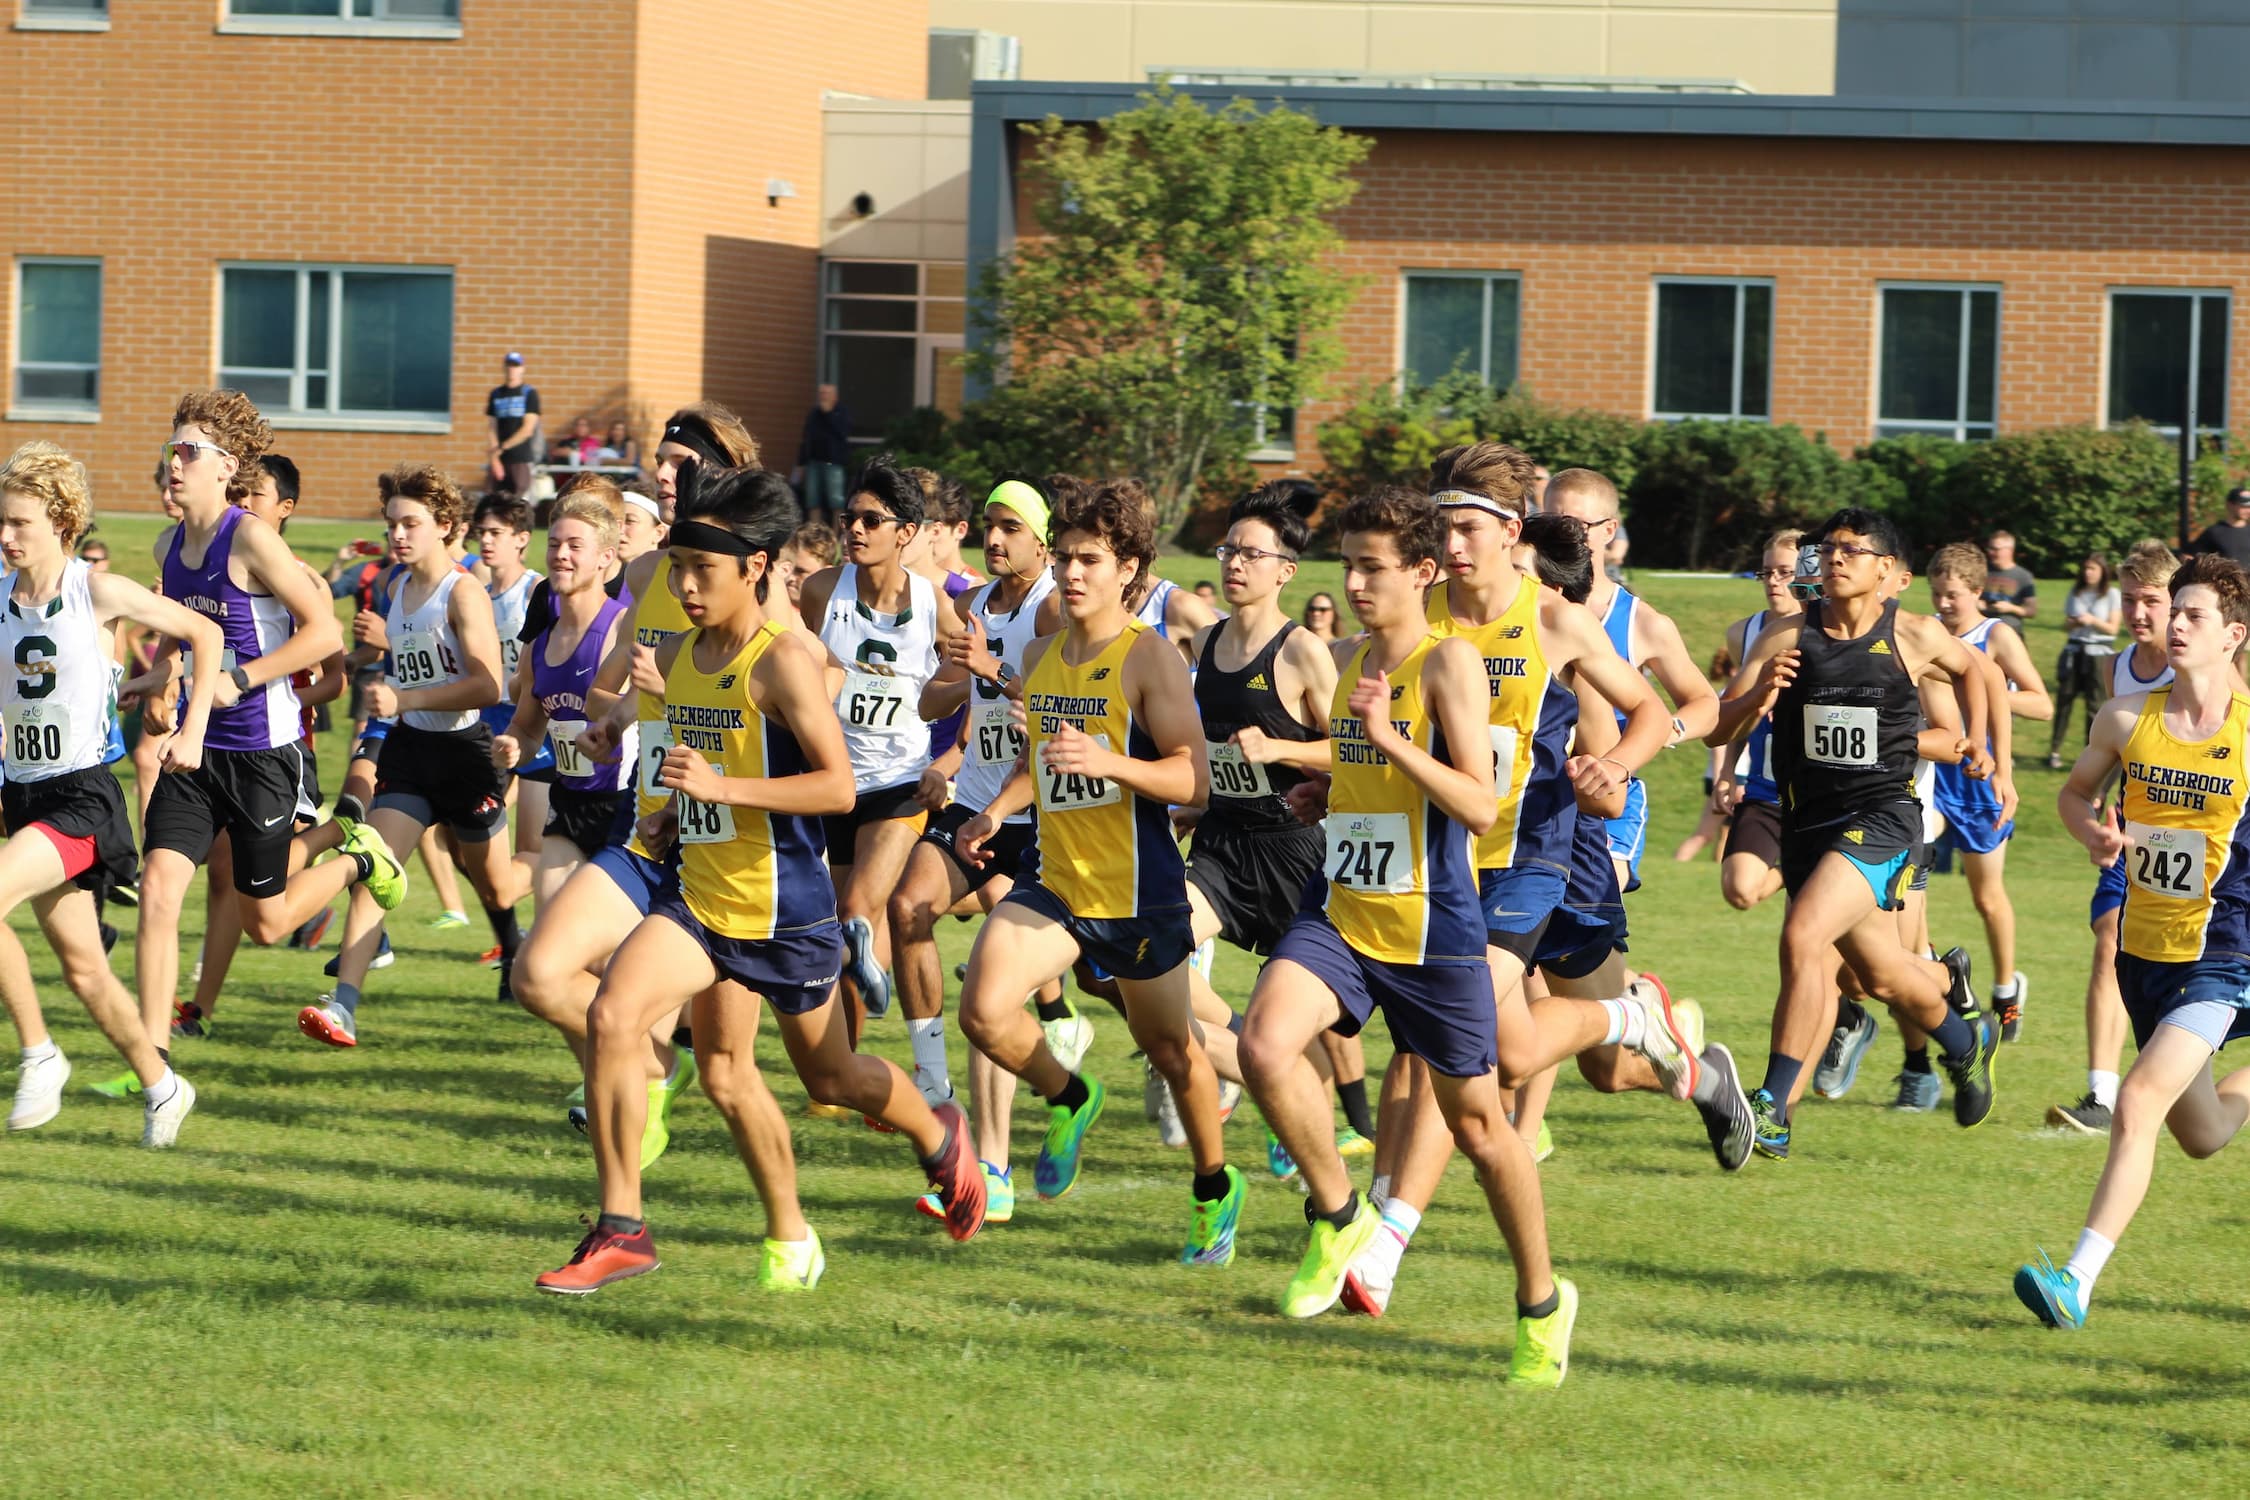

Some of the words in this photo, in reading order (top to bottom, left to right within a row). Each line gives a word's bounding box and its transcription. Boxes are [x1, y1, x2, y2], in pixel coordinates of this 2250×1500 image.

[15, 635, 57, 699] S
[397, 650, 434, 684] 599
[667, 704, 745, 729] GLENBROOK
[850, 693, 902, 726] 677
[1029, 694, 1108, 716] GLENBROOK
[681, 729, 724, 751] SOUTH
[1041, 715, 1085, 734] SOH
[14, 724, 61, 761] 680
[979, 723, 1024, 761] 679
[1338, 742, 1388, 765] SOUTH
[1814, 725, 1865, 759] 508
[1209, 760, 1258, 792] 509
[2128, 761, 2234, 796] GLENBROOK
[678, 791, 721, 835] 248
[2146, 785, 2206, 811] SOUTH
[1334, 839, 1395, 885] 247
[2135, 846, 2192, 891] 242
